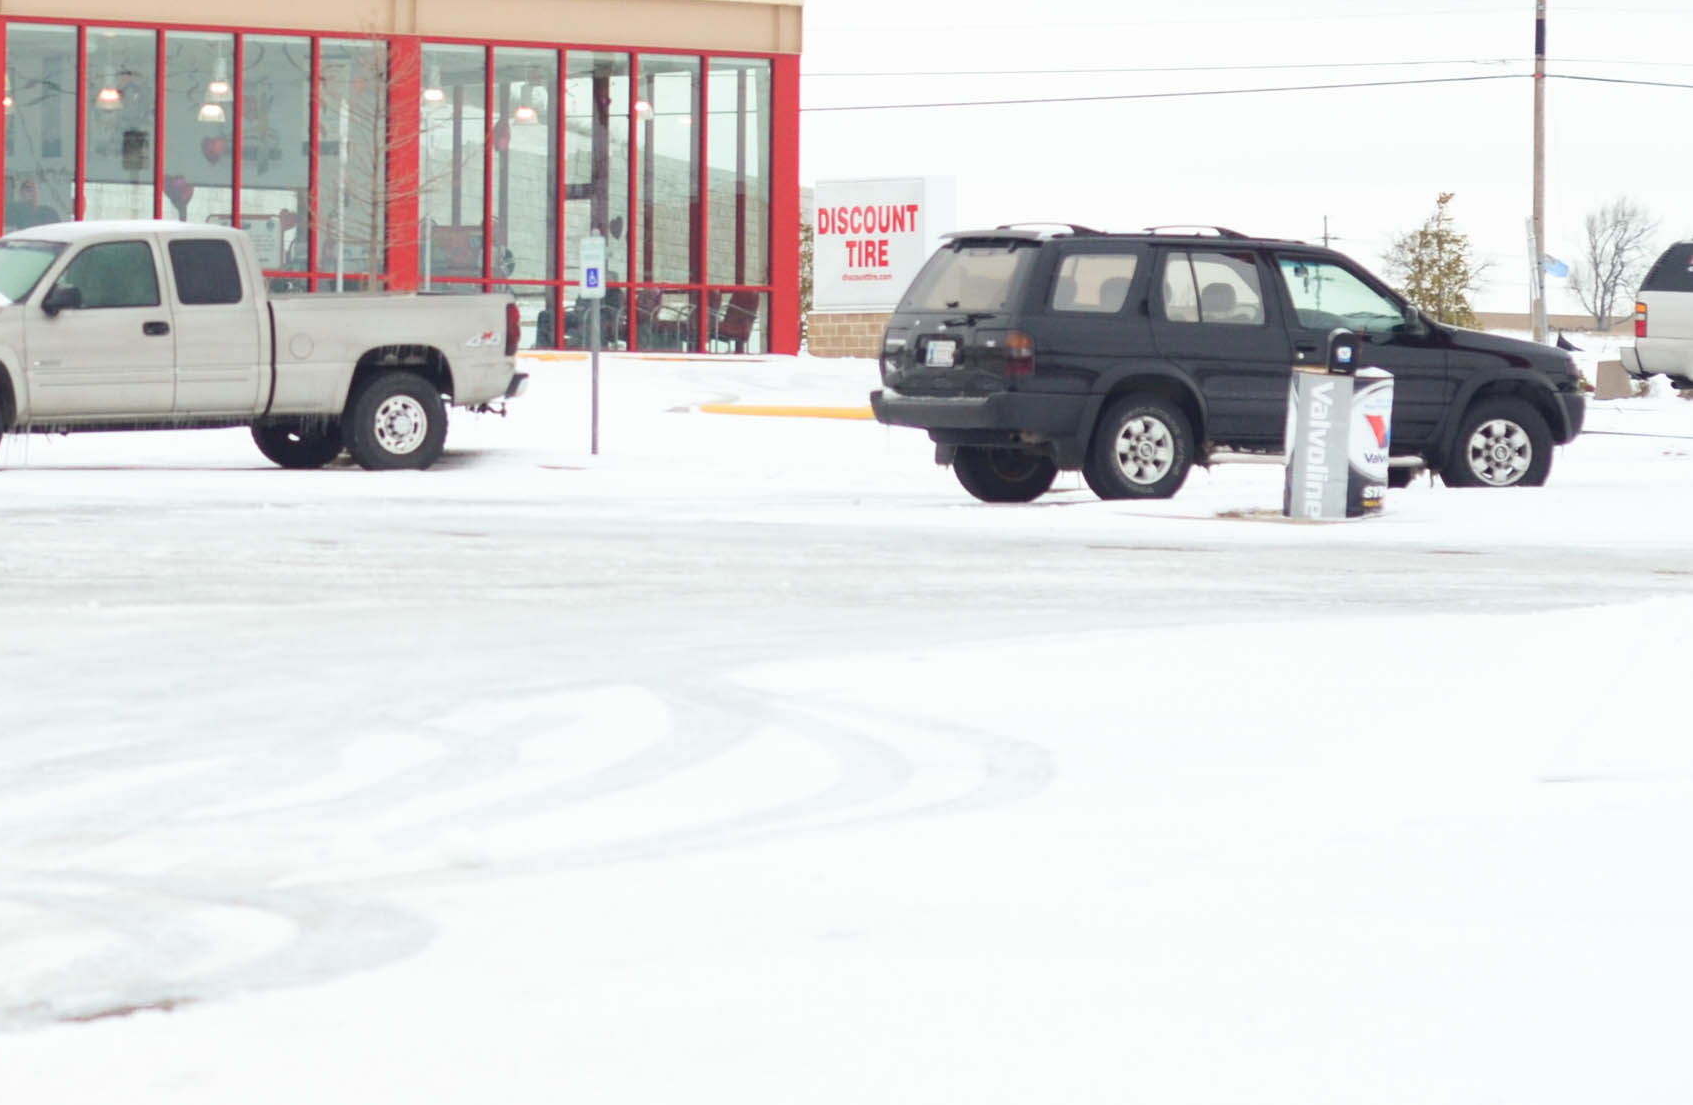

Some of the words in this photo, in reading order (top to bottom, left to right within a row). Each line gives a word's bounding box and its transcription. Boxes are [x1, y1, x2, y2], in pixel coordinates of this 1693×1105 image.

[818, 204, 919, 235] DISCOUNT
[846, 239, 889, 268] TIRE
[1305, 381, 1336, 518] Valvoline
